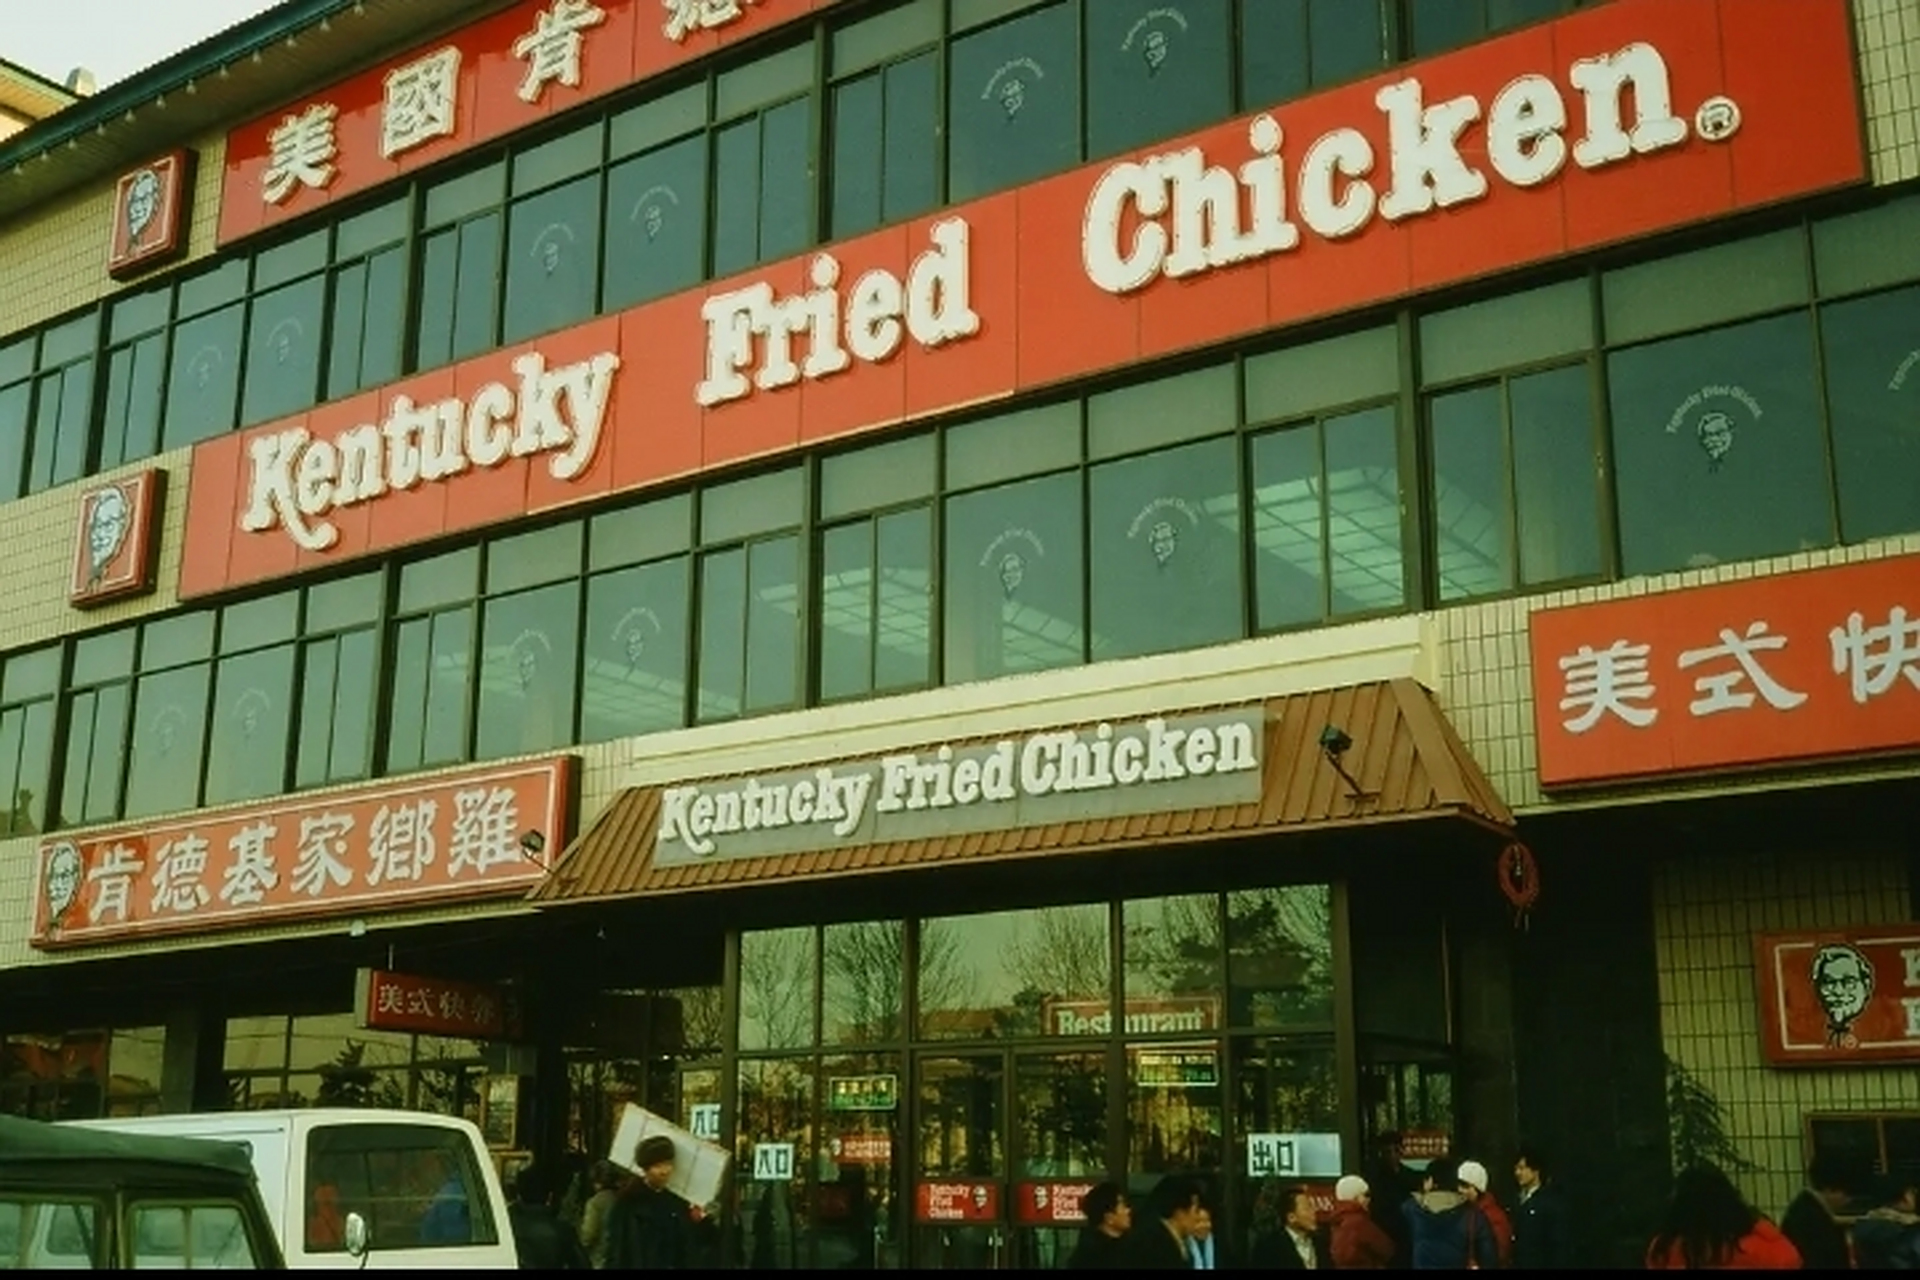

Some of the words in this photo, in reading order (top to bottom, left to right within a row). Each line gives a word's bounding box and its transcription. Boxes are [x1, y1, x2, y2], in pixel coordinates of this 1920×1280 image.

[242, 351, 620, 550] Kentucky
[695, 216, 981, 407] Fried
[1082, 41, 1688, 293] Chicken
[658, 767, 874, 854] Kentucky
[876, 741, 1015, 813] Fried
[1020, 718, 1258, 797] Chicken
[86, 787, 528, 923] 肯德基家鄉雞
[1057, 1008, 1206, 1035] Resturant
[757, 1148, 789, 1175] 入口
[1253, 1140, 1294, 1172] 出口
